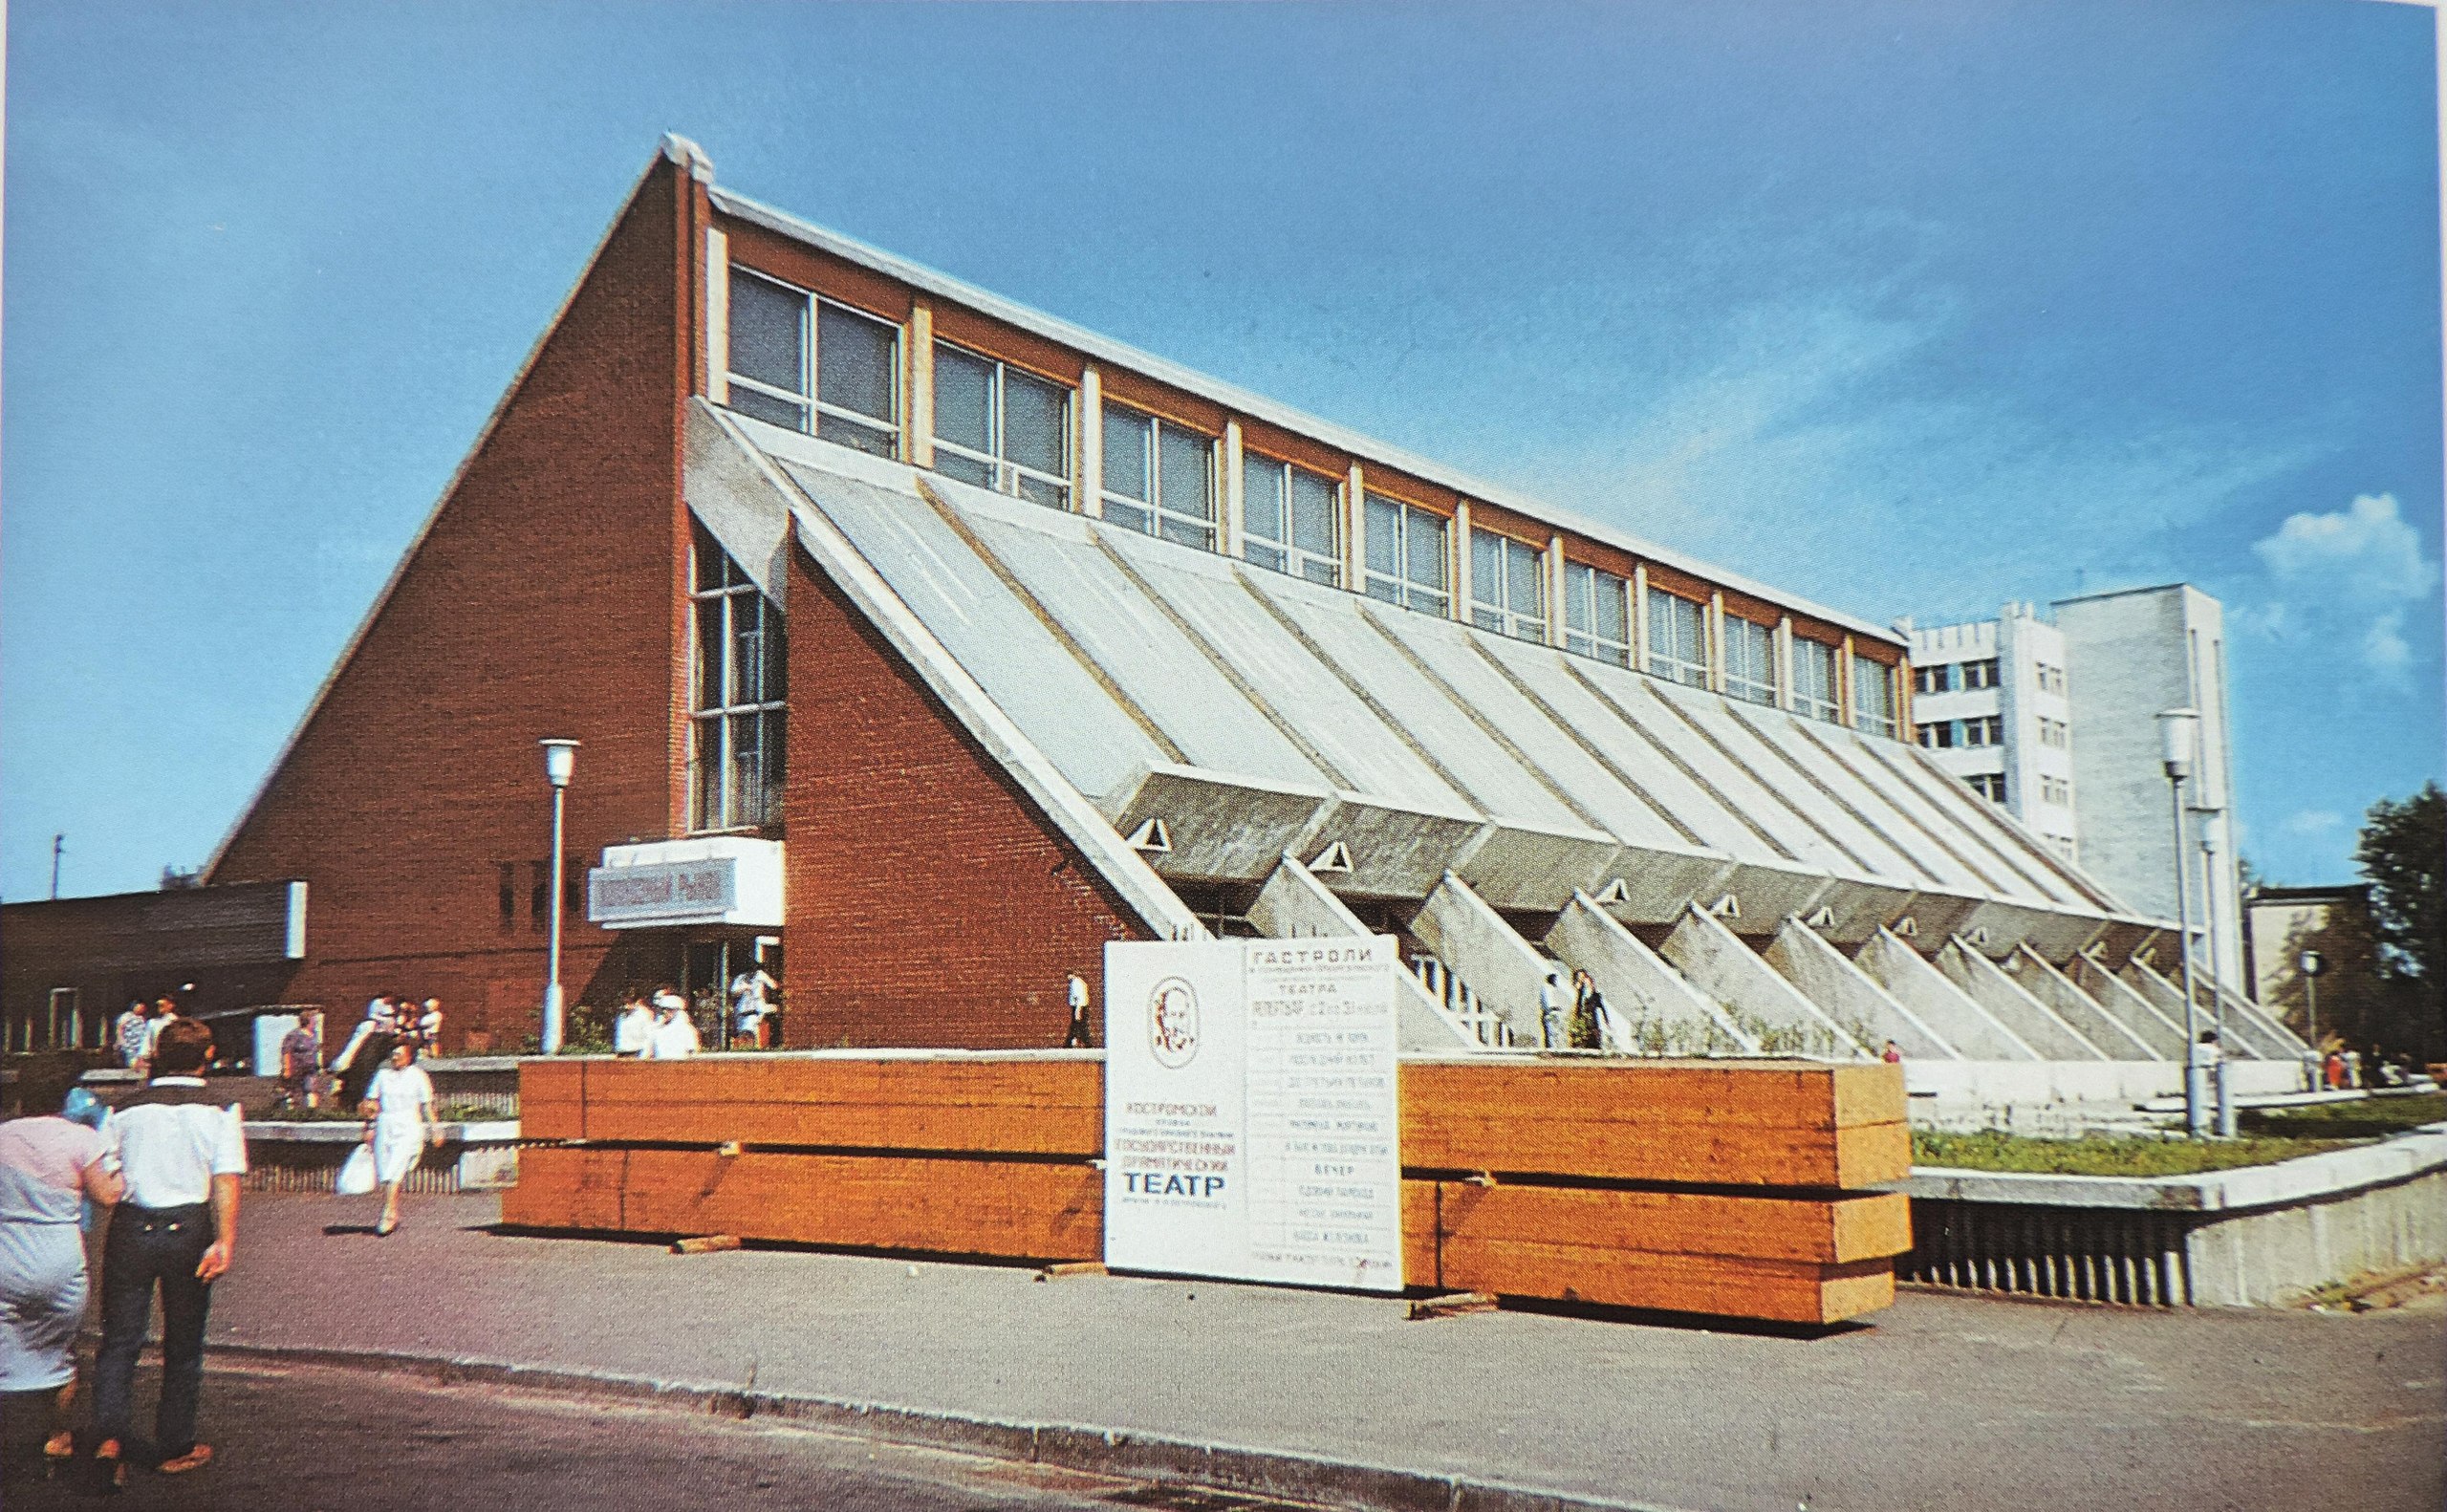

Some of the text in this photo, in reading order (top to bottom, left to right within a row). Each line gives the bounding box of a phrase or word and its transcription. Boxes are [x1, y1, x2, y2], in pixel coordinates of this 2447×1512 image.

[1252, 948, 1373, 964] ГАСТРОЛИ
[1279, 983, 1338, 995] ТЕАТРА
[1122, 1171, 1225, 1198] ТЕАТР
